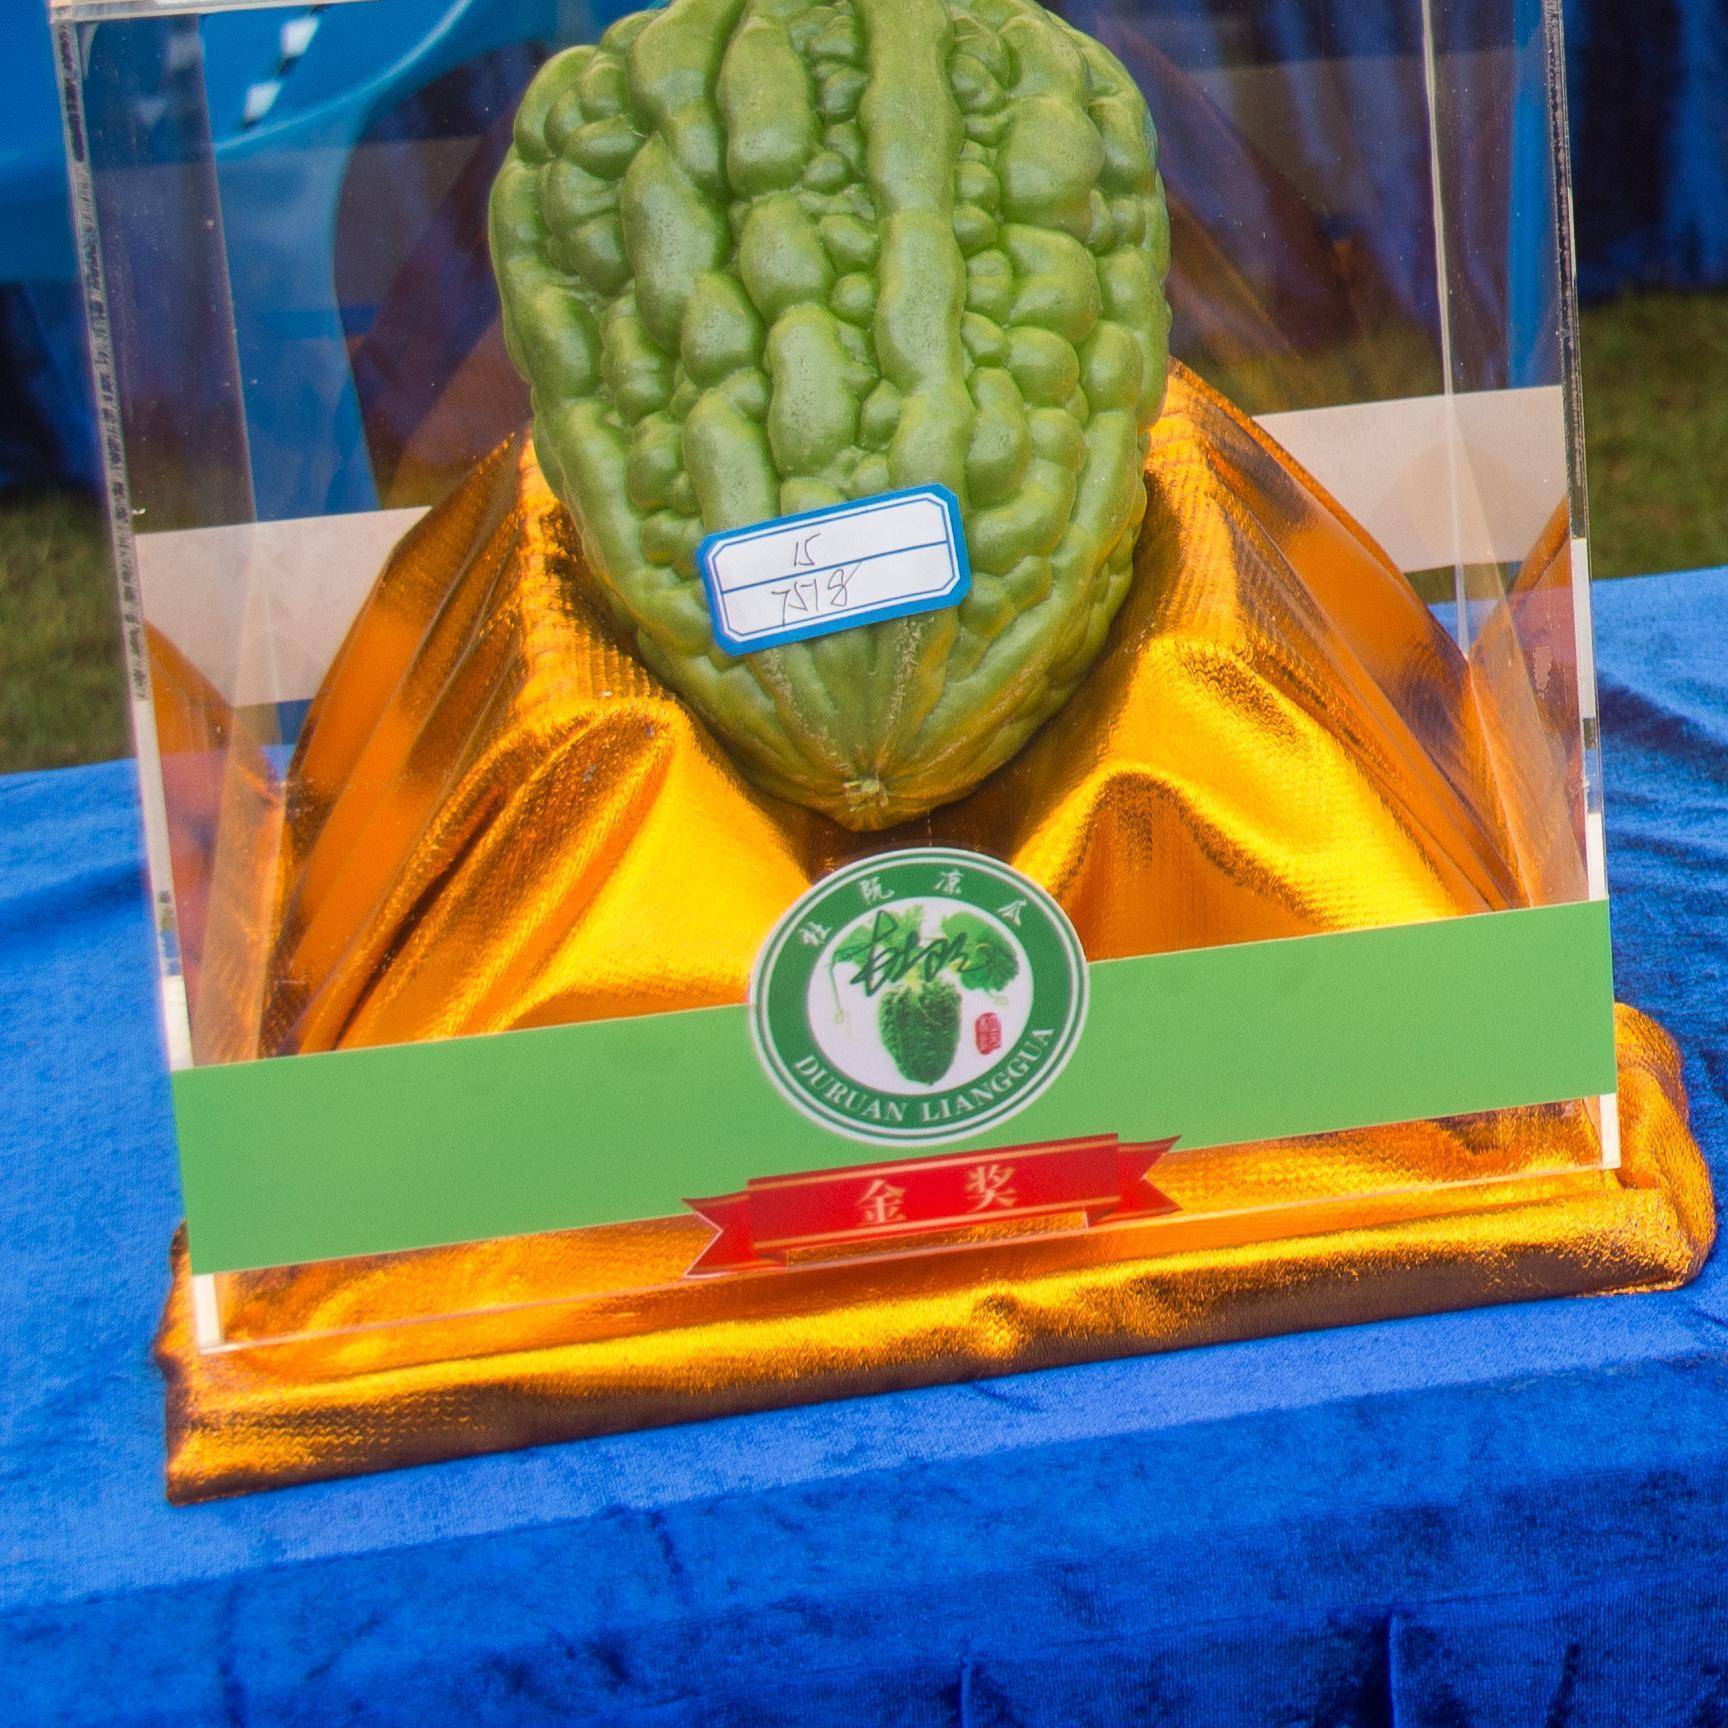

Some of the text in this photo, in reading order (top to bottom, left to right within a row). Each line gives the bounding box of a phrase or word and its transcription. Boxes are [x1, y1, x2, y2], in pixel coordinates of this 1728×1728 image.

[794, 533, 821, 566] 15
[794, 1054, 908, 1123] DURUAN
[920, 1027, 1055, 1123] LIANGGUA
[857, 1164, 1018, 1224] 金奖
